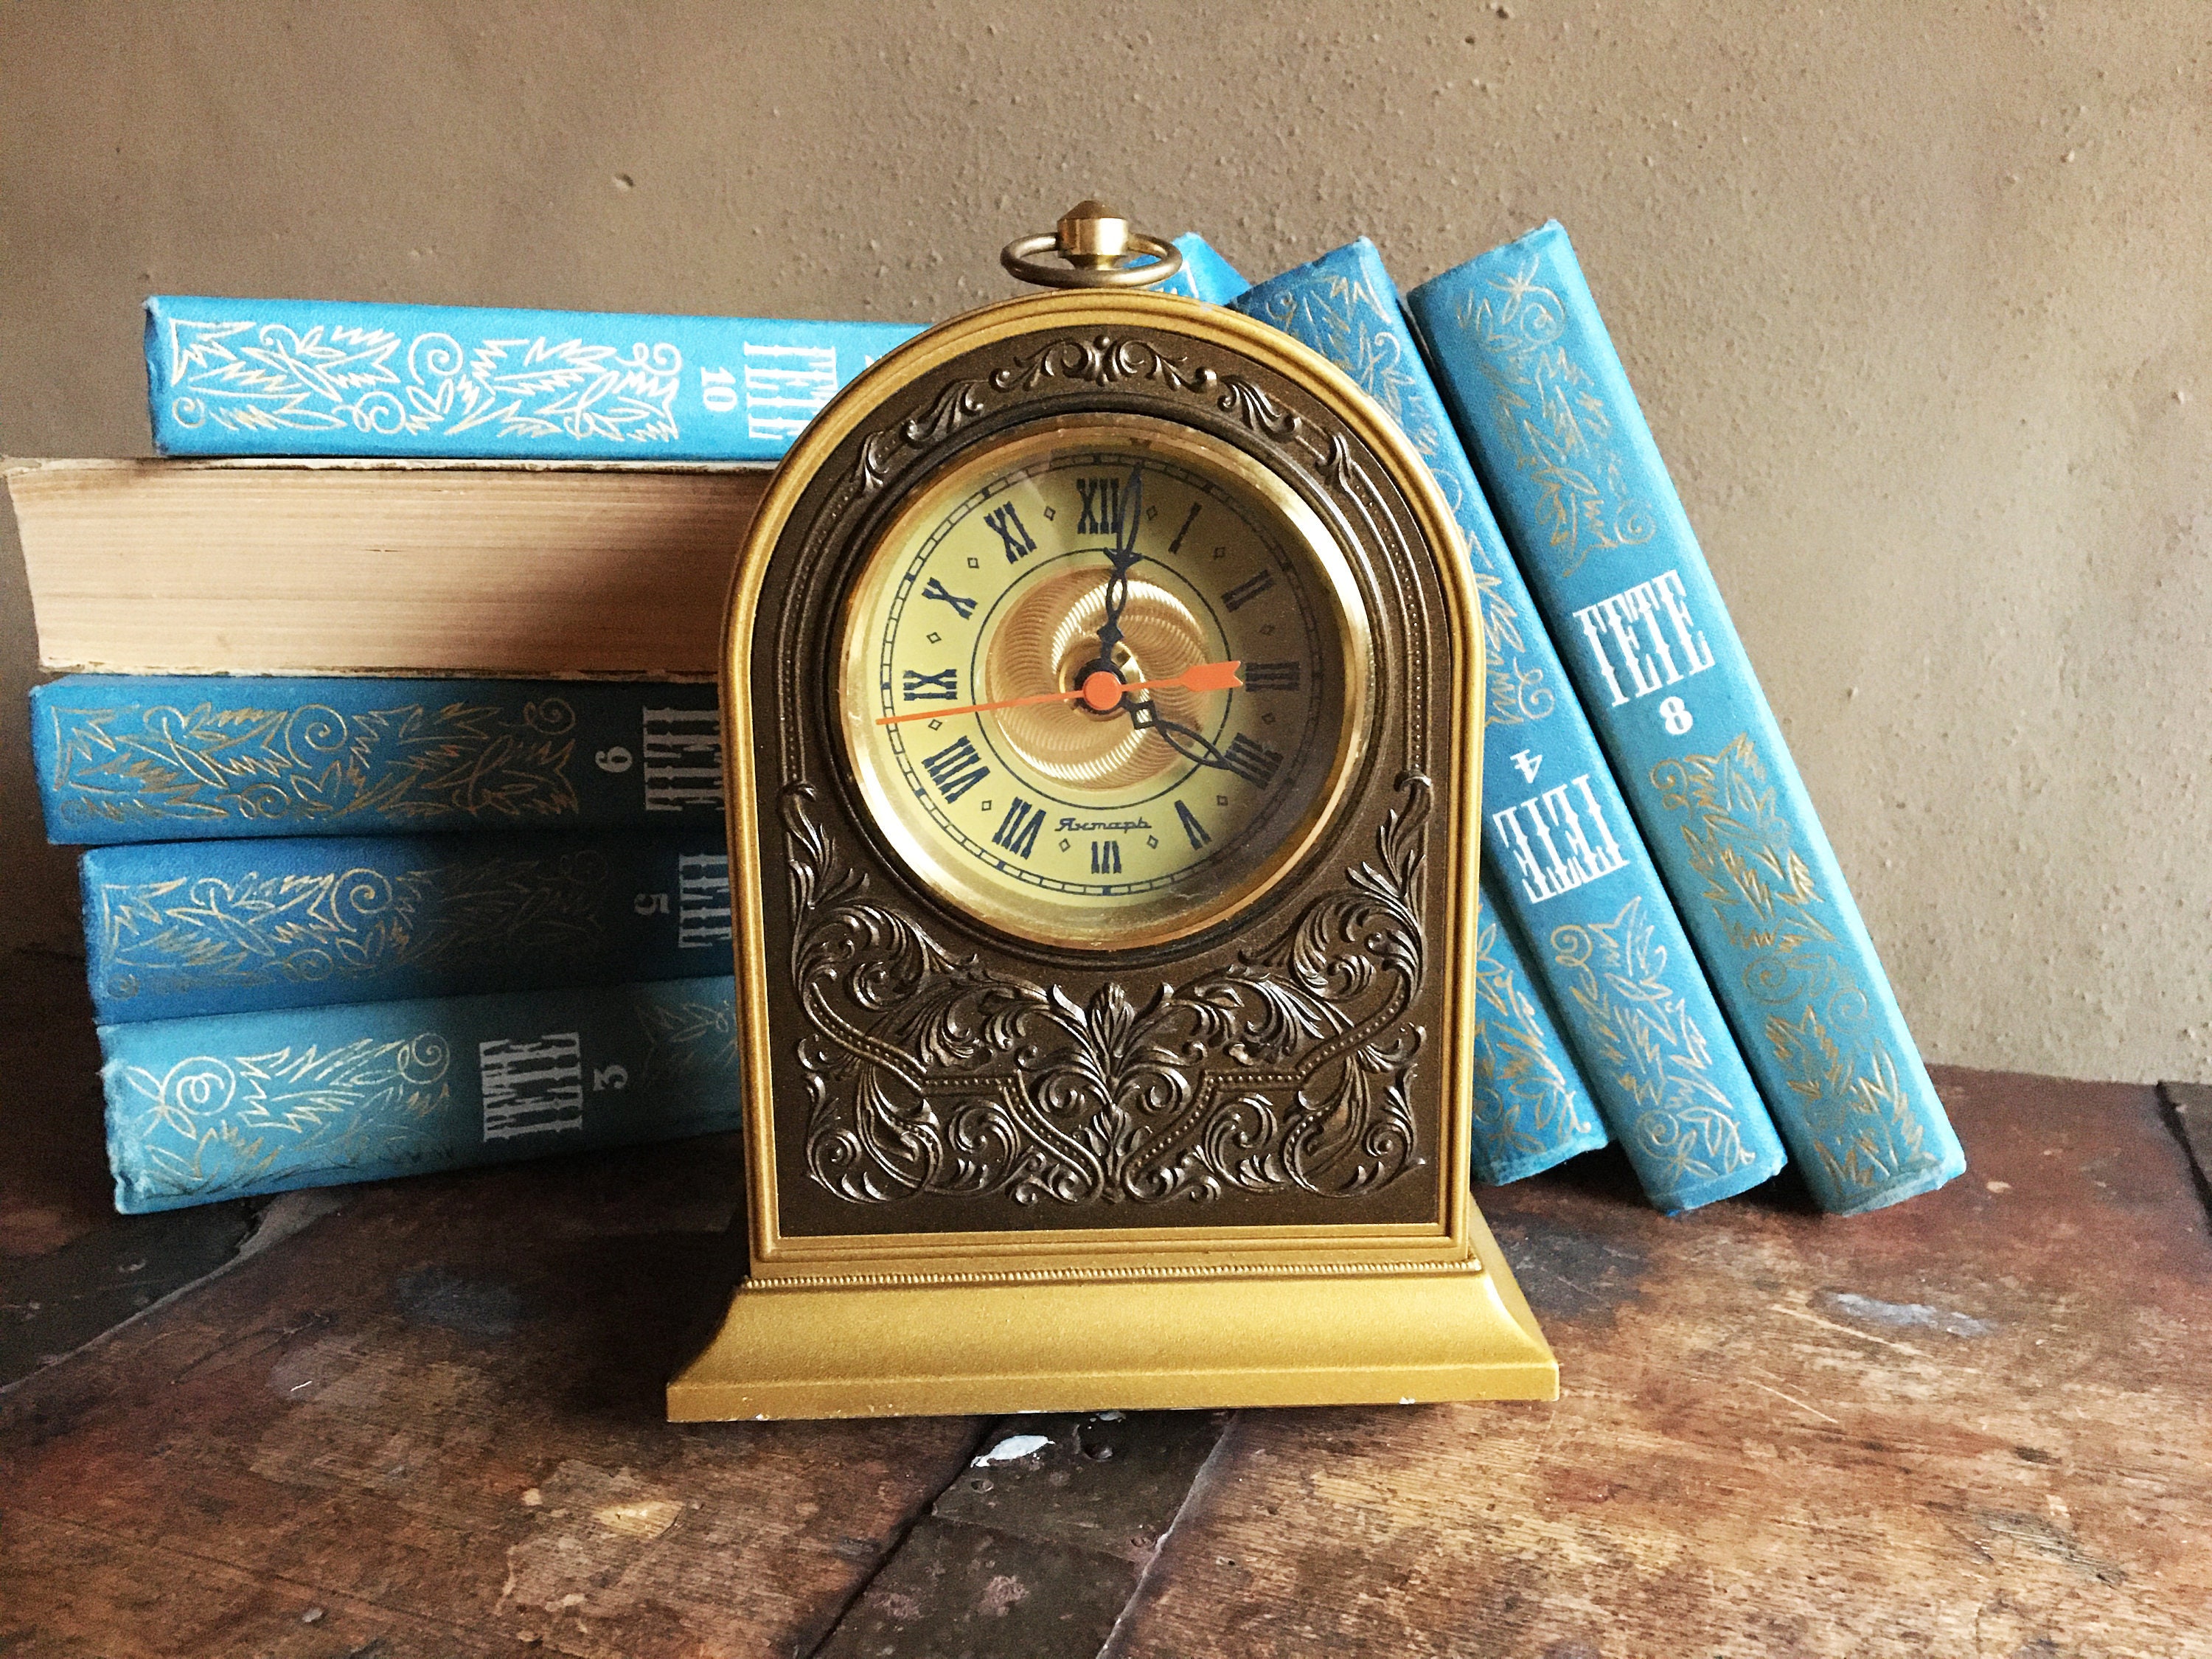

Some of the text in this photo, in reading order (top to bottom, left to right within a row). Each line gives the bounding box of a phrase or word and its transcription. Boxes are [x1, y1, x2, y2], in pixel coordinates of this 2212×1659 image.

[701, 366, 737, 411] 10
[1077, 478, 1121, 534] XII
[984, 501, 1037, 564] XI
[922, 577, 978, 620] X
[1221, 570, 1275, 613] II
[1572, 569, 1716, 707] ГЕТЕ
[903, 669, 958, 701] IX
[1245, 662, 1300, 692] III
[1660, 696, 1694, 736] 8
[922, 735, 991, 804] VIII
[1510, 748, 1543, 784] 4
[992, 797, 1046, 860] VII
[1054, 816, 1152, 834] Янтарь
[1174, 800, 1211, 850] V
[1492, 773, 1630, 904] ГЕТЕ
[1091, 841, 1122, 874] VI
[633, 892, 669, 916] 5
[479, 1032, 583, 1143] ГЕТЕ
[593, 1064, 628, 1091] 3
